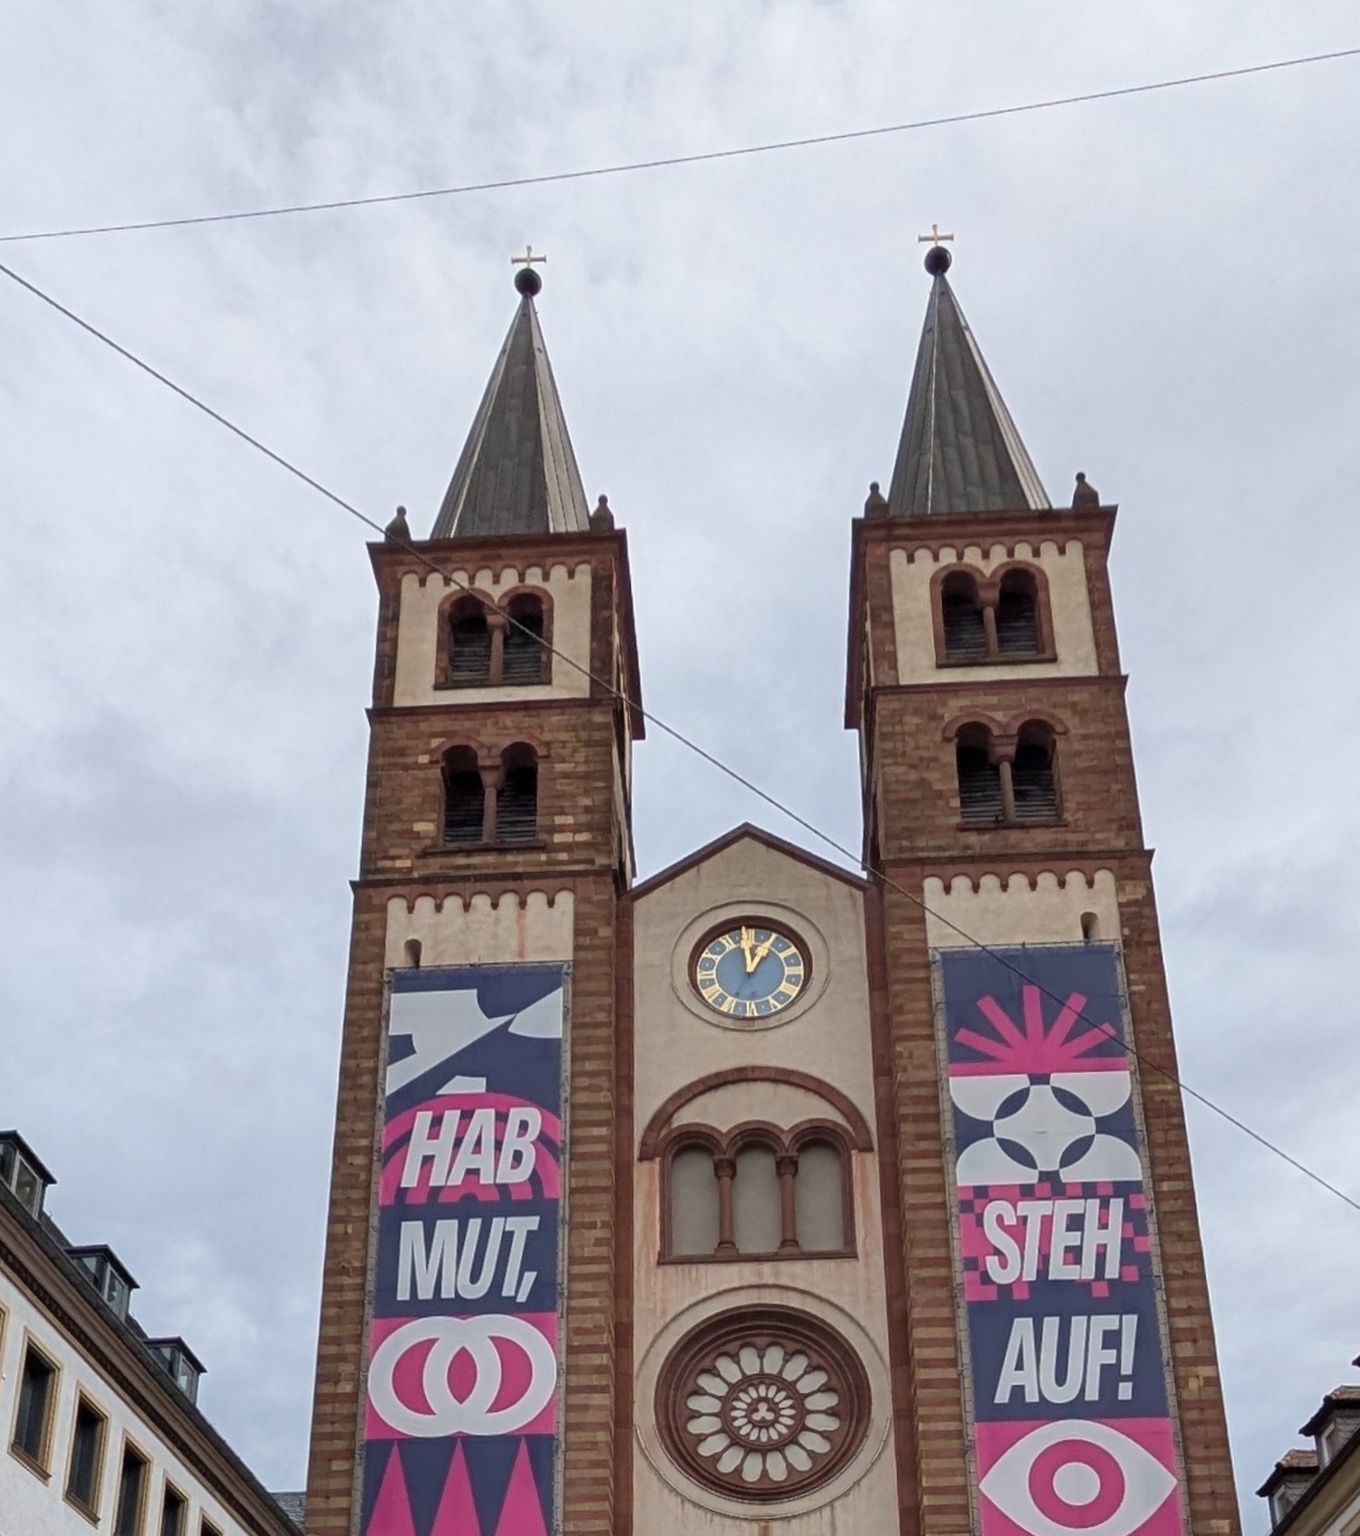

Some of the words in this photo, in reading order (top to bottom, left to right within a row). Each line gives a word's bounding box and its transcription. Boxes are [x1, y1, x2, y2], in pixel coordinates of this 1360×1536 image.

[400, 1106, 542, 1189] HAB
[395, 1214, 540, 1303] MUT,
[983, 1197, 1124, 1287] STEH
[994, 1314, 1137, 1403] AUF!
